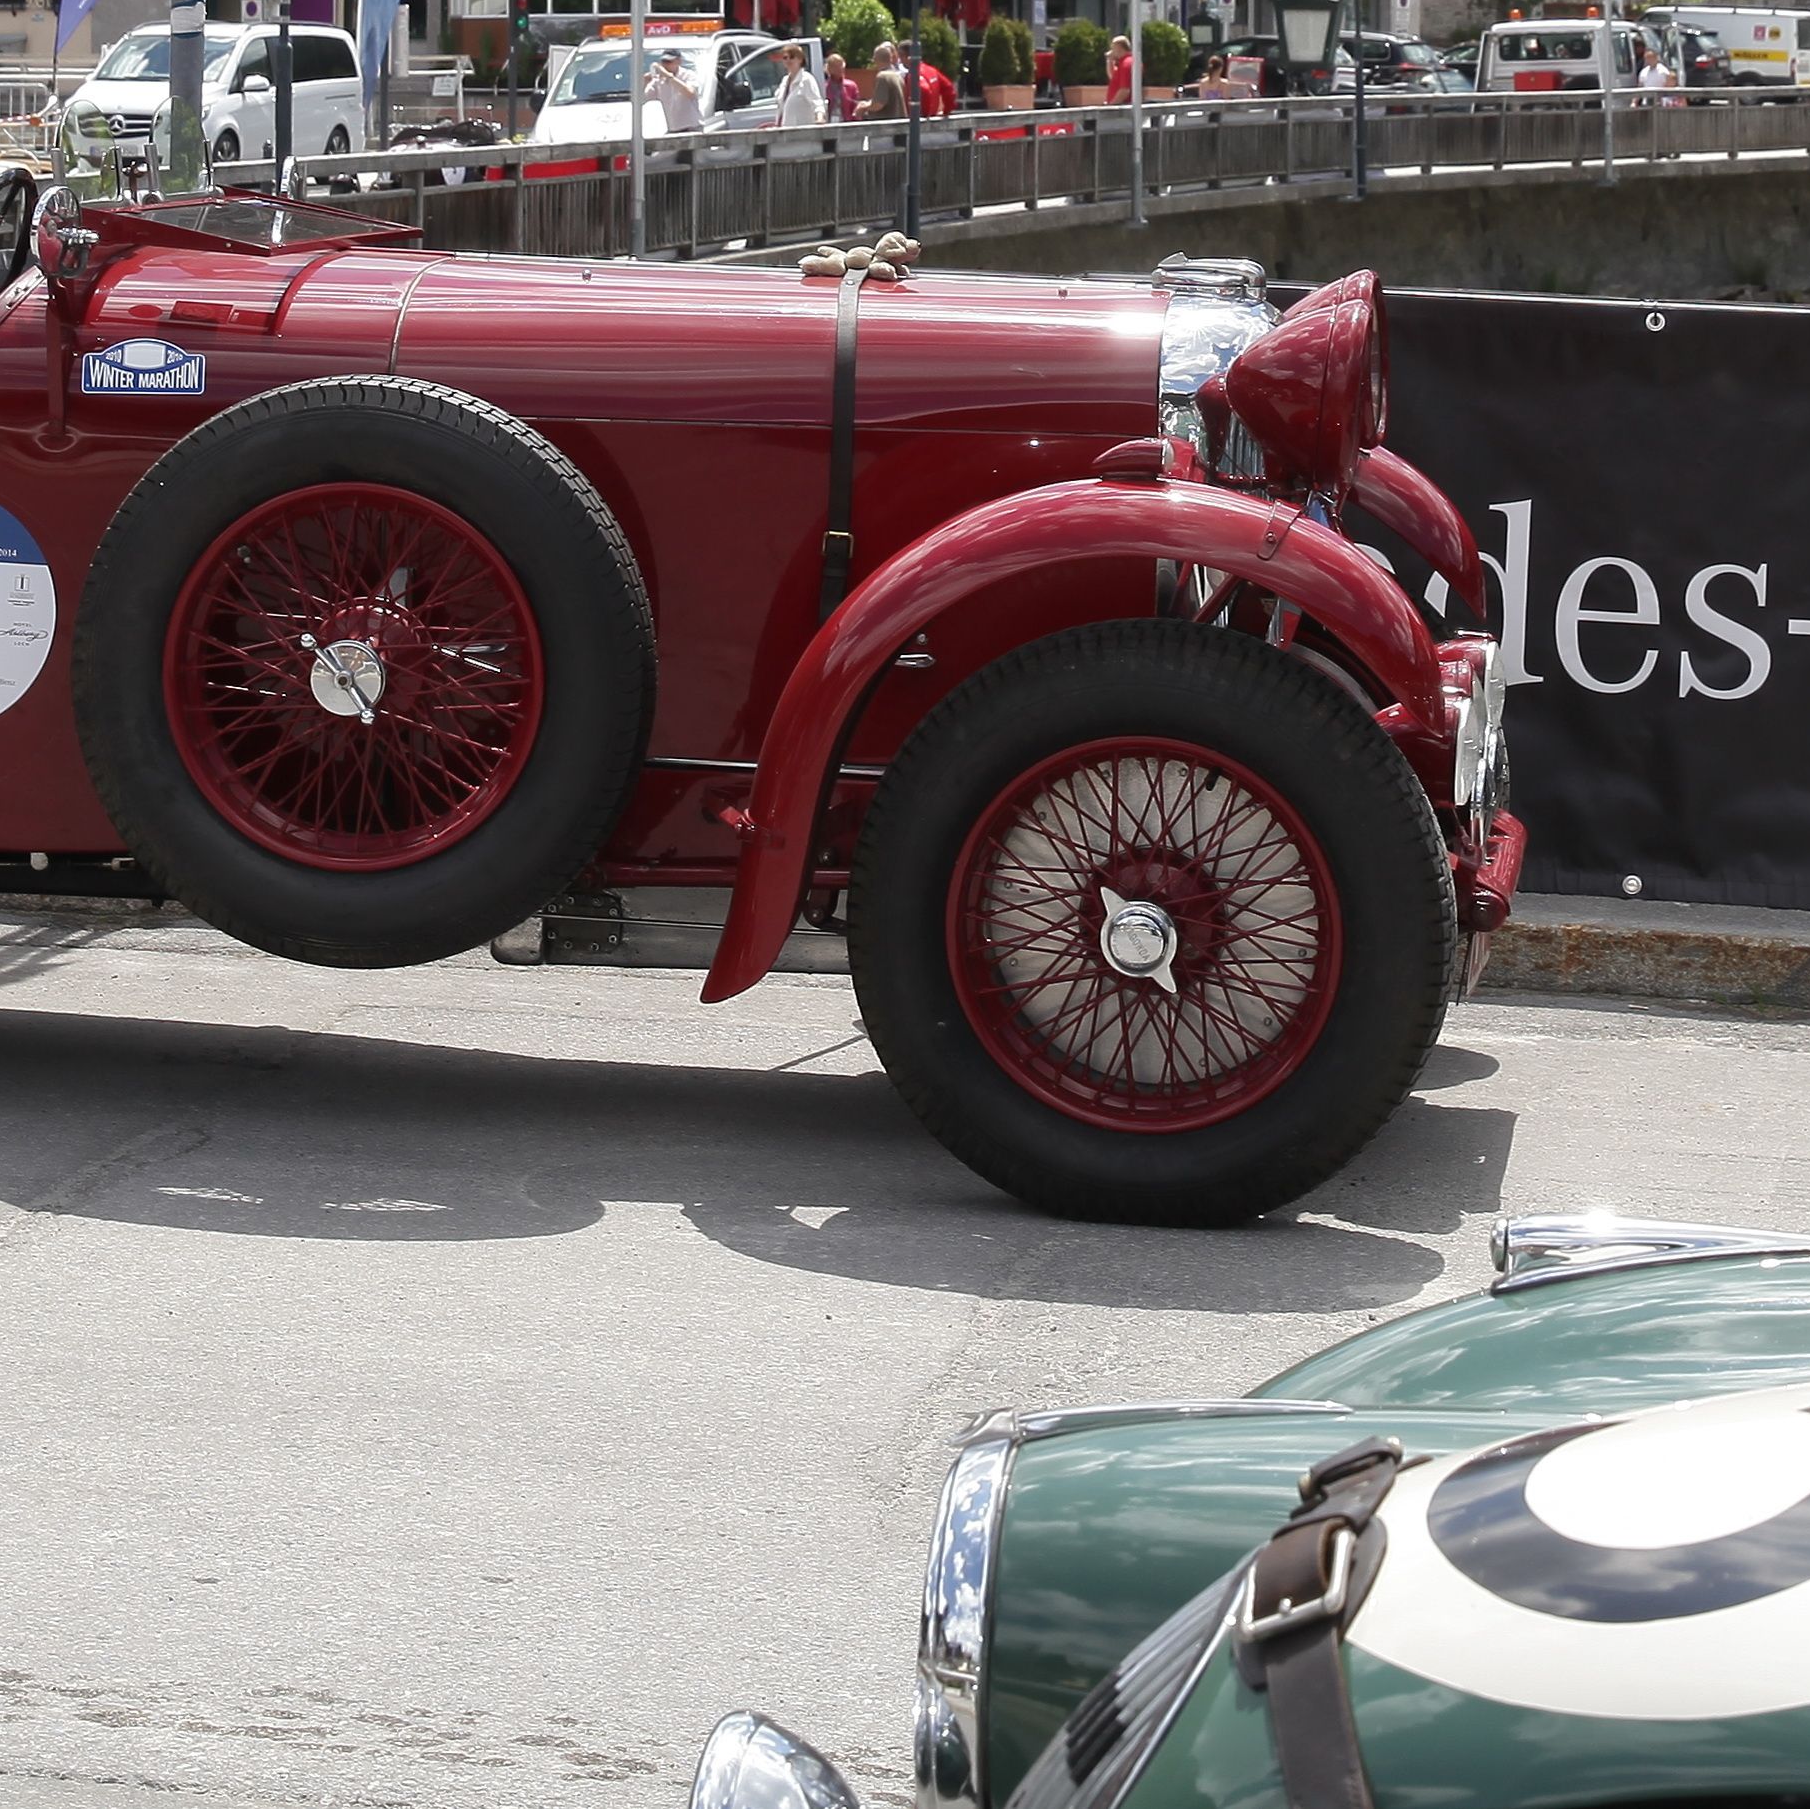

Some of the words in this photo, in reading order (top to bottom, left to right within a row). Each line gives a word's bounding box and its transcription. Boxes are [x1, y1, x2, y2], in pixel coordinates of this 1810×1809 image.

[647, 24, 671, 35] AvD
[89, 355, 134, 388] WINTER
[138, 356, 199, 389] MARATHON
